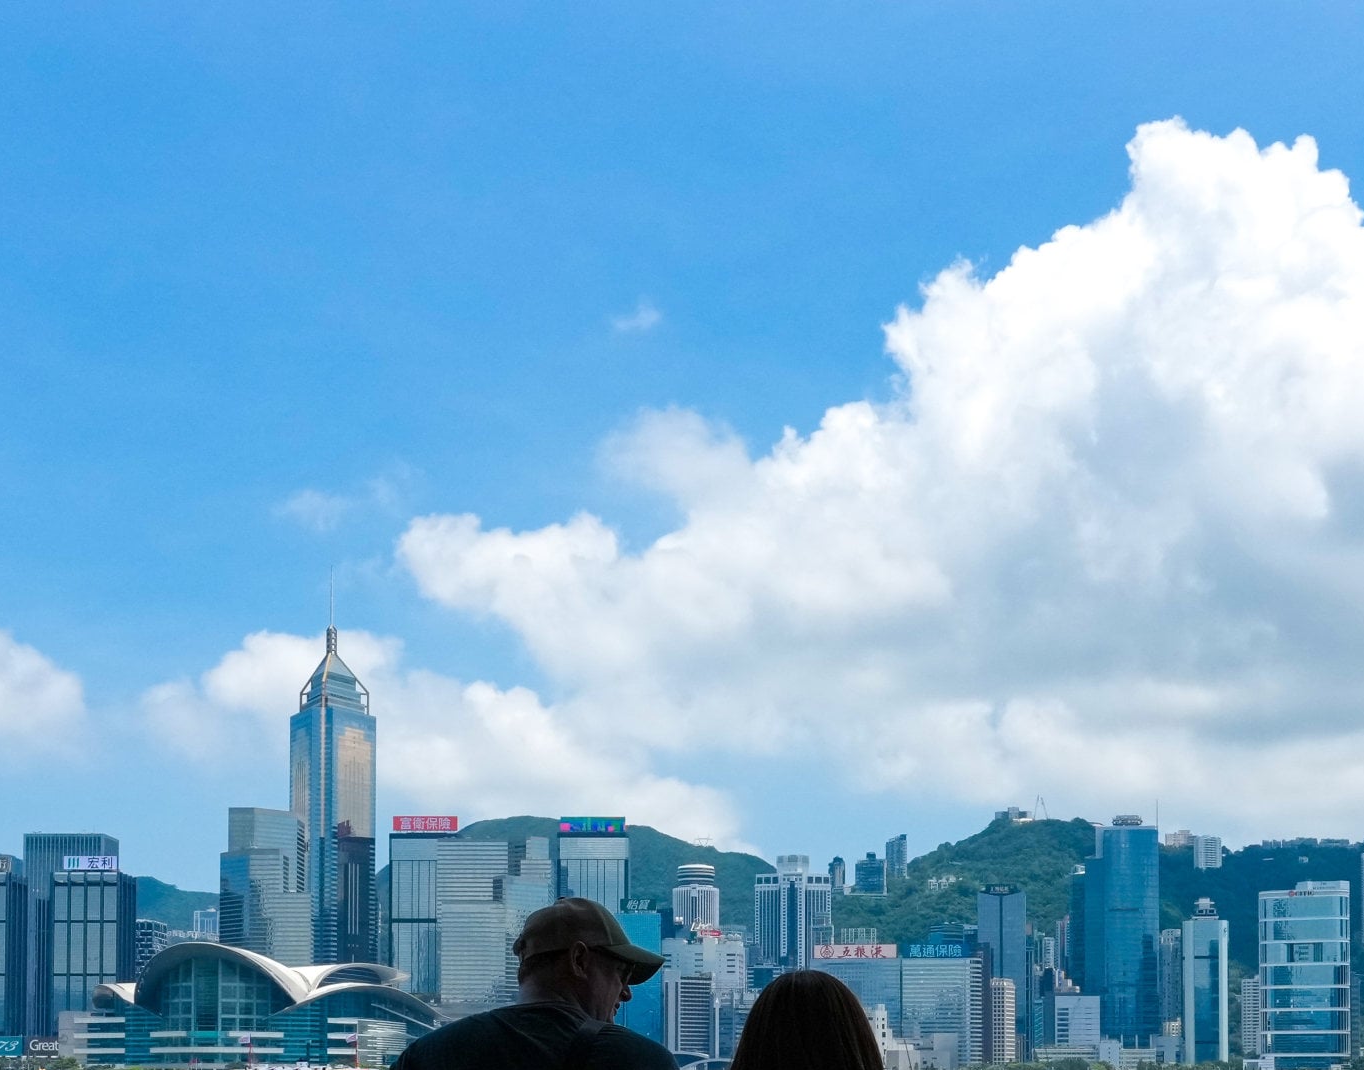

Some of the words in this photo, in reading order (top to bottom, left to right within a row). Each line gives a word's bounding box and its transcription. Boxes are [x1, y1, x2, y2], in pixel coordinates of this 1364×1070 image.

[400, 817, 452, 830] 富衛保險
[87, 856, 114, 869] 宏利
[909, 944, 963, 958] 萬通保險
[29, 1039, 59, 1051] Great
